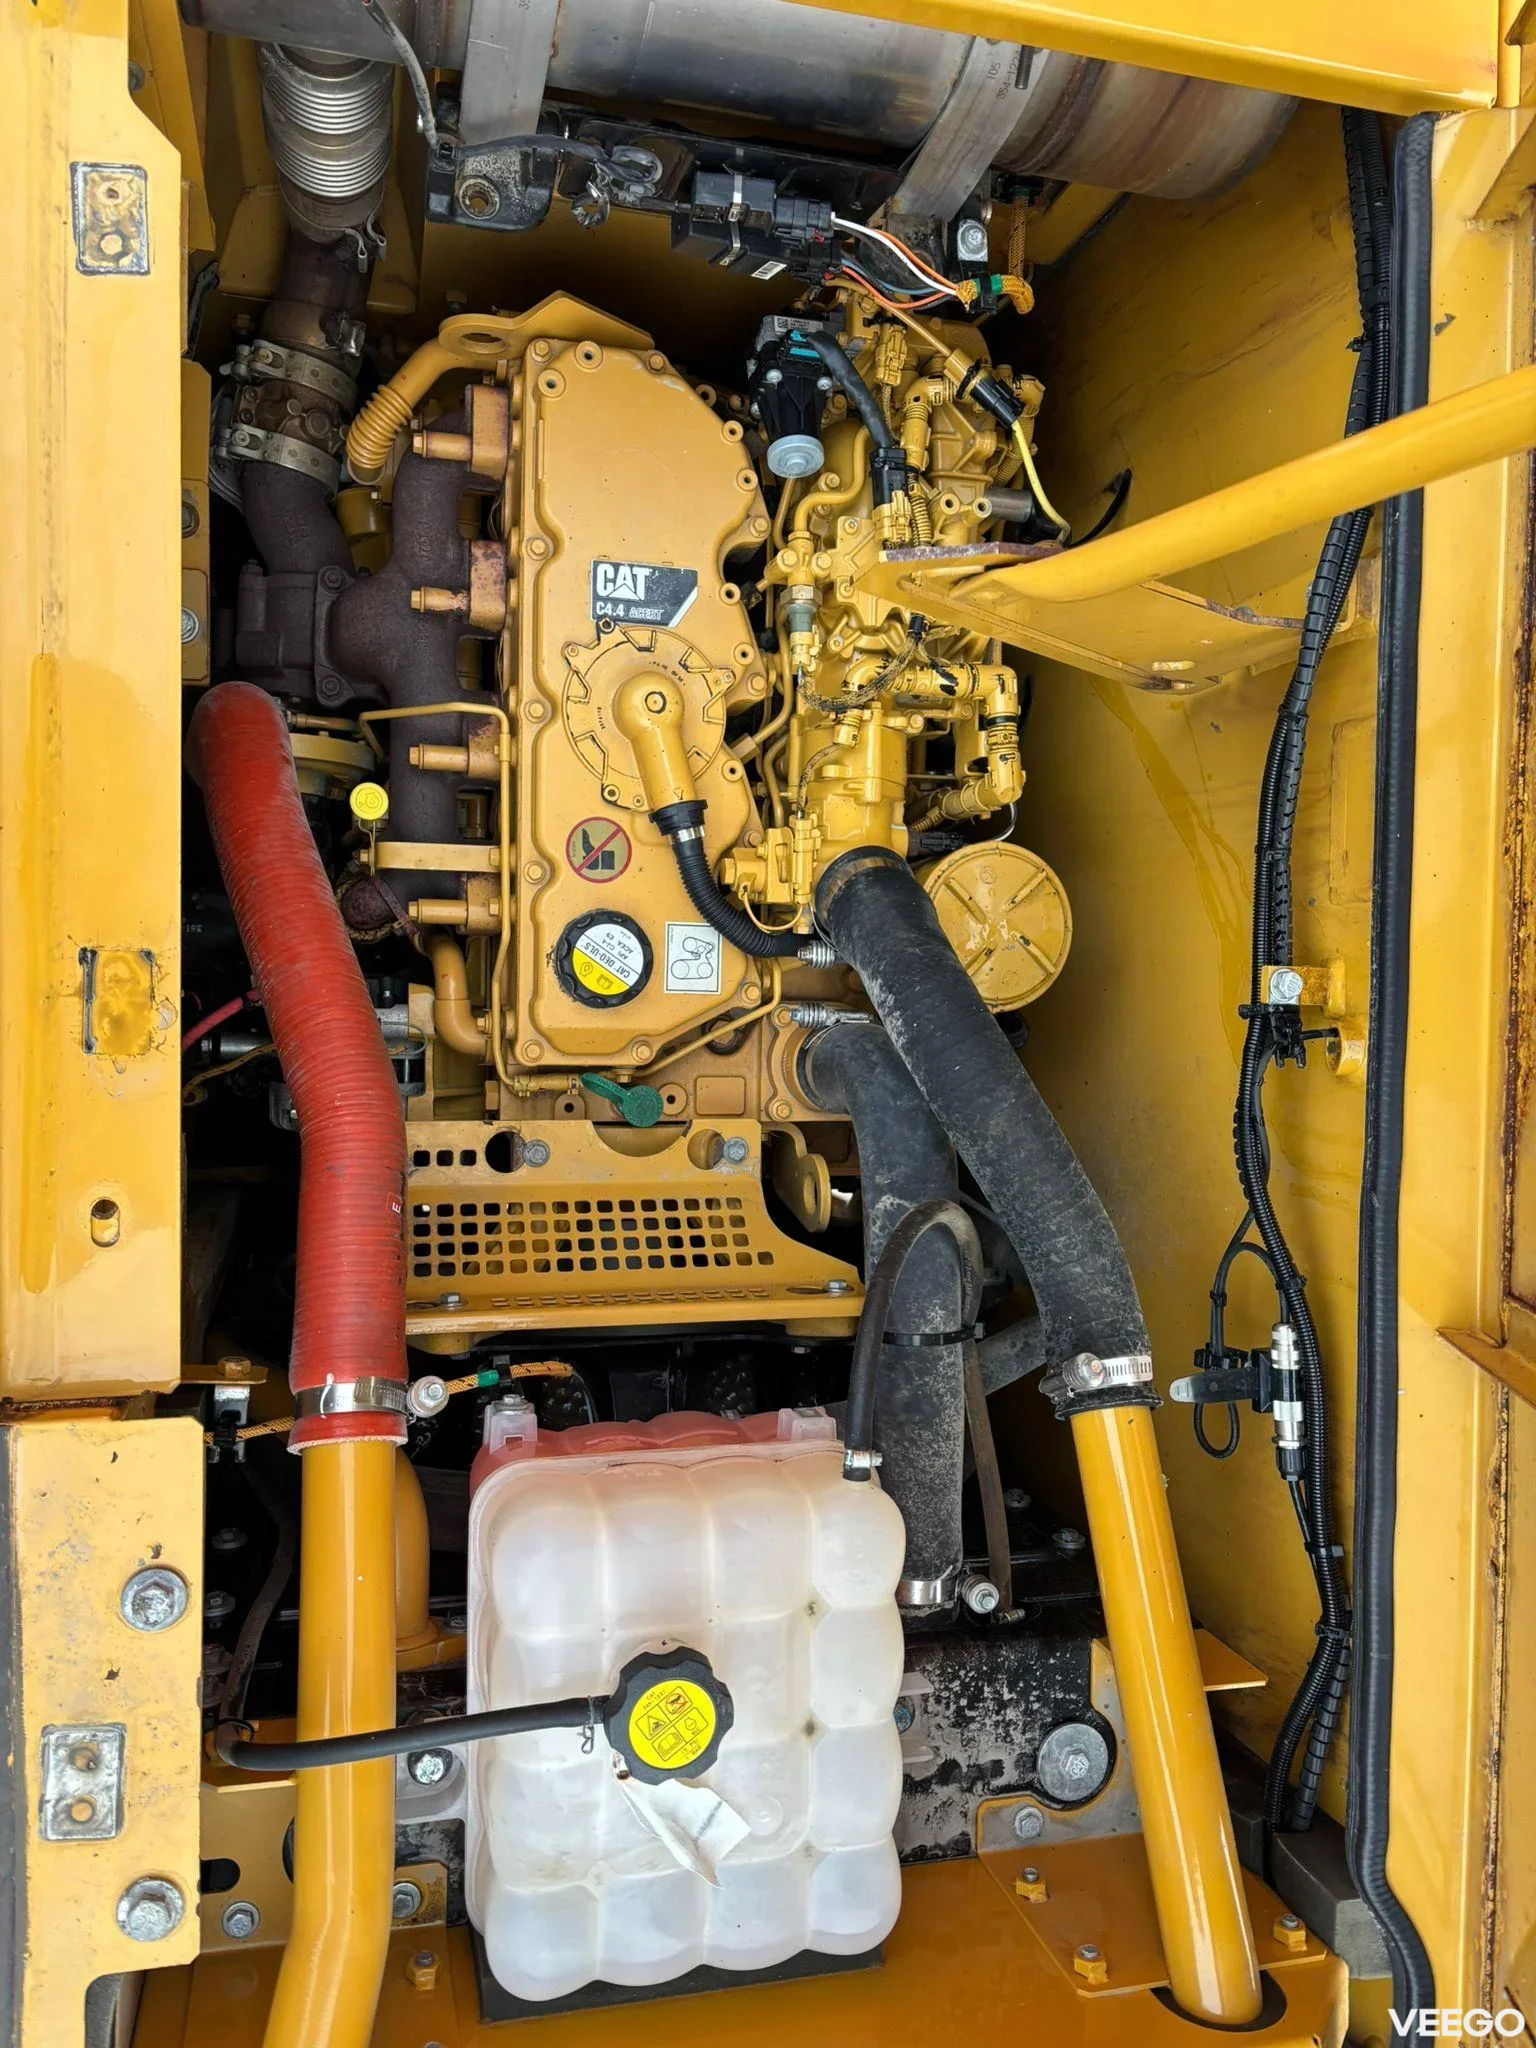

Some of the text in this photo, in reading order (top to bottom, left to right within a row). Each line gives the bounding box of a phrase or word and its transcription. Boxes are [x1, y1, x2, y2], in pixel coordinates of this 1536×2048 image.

[596, 563, 650, 600] CAT
[596, 602, 664, 620] C4.4 ACERT
[617, 966, 631, 978] CAT
